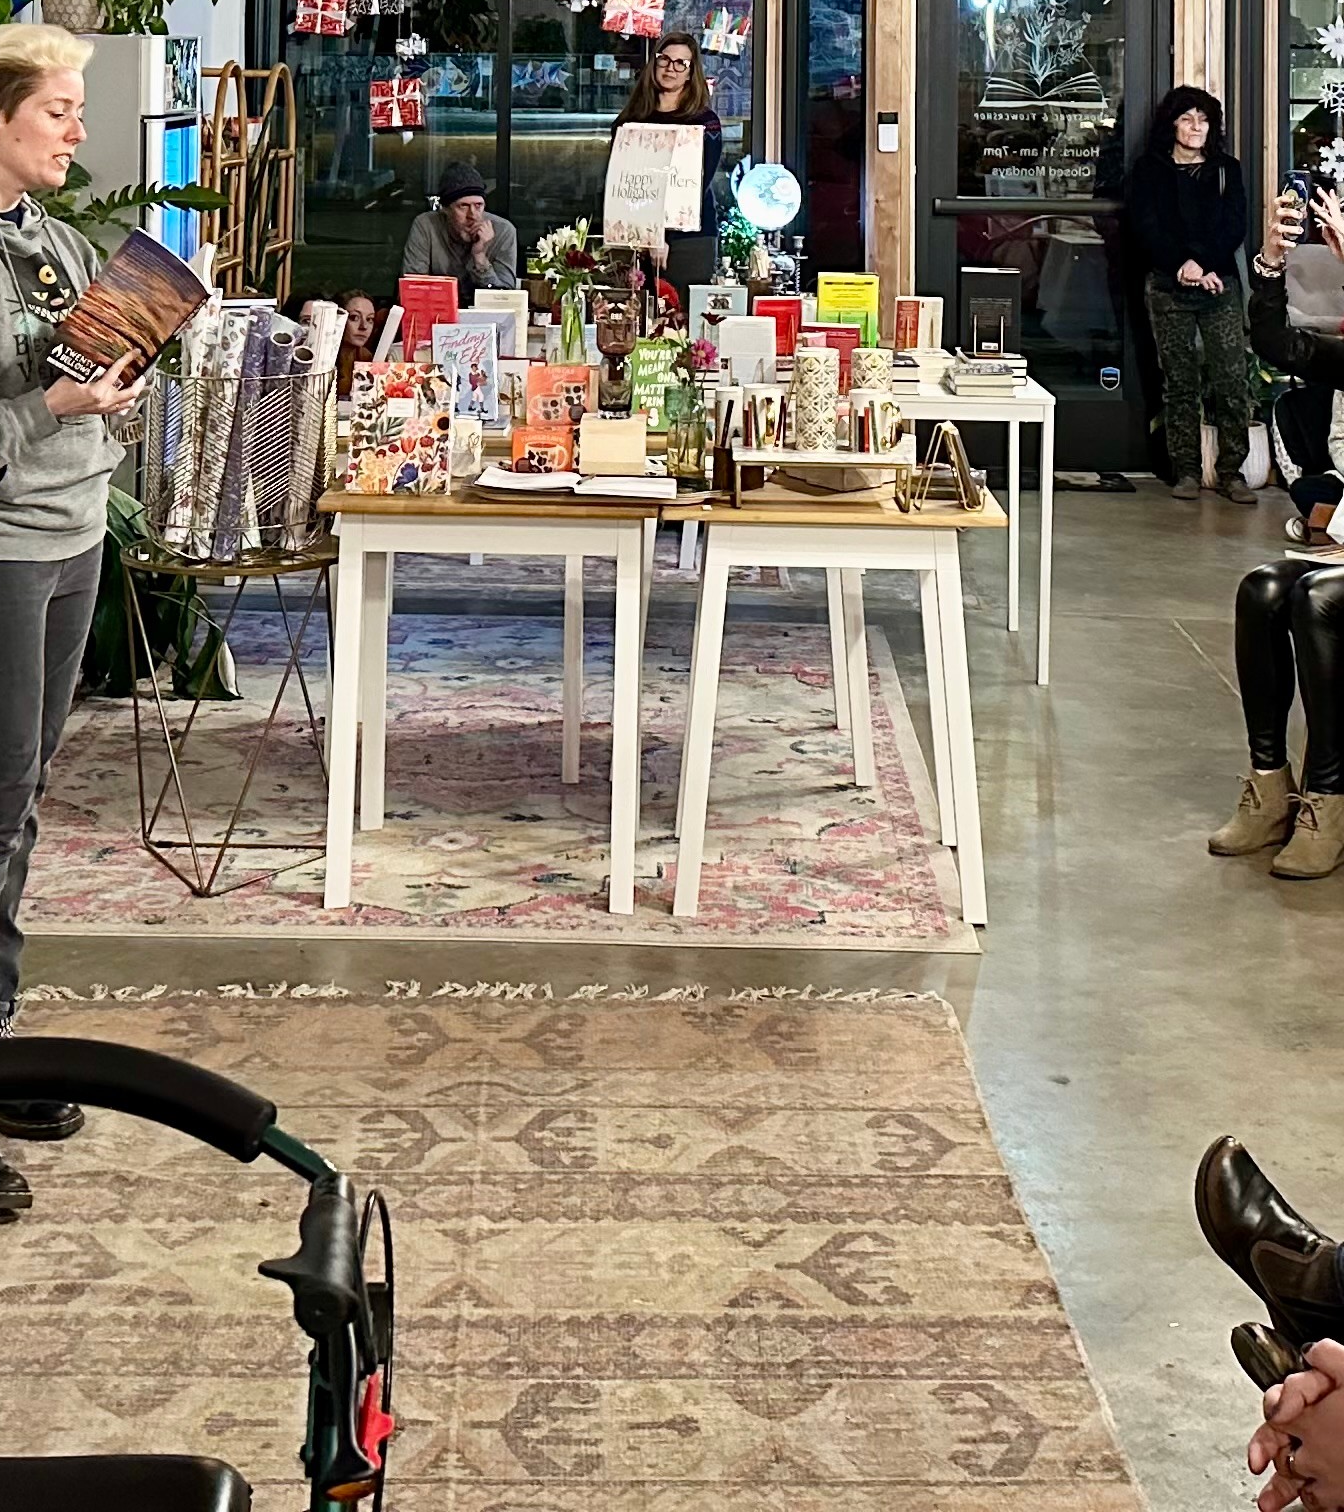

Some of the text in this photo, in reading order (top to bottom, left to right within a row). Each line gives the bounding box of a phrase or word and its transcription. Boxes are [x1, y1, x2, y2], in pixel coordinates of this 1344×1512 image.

[620, 171, 654, 190] Happy
[64, 346, 96, 369] TWENTY
[638, 361, 665, 376] MEAN
[634, 382, 665, 395] MATT
